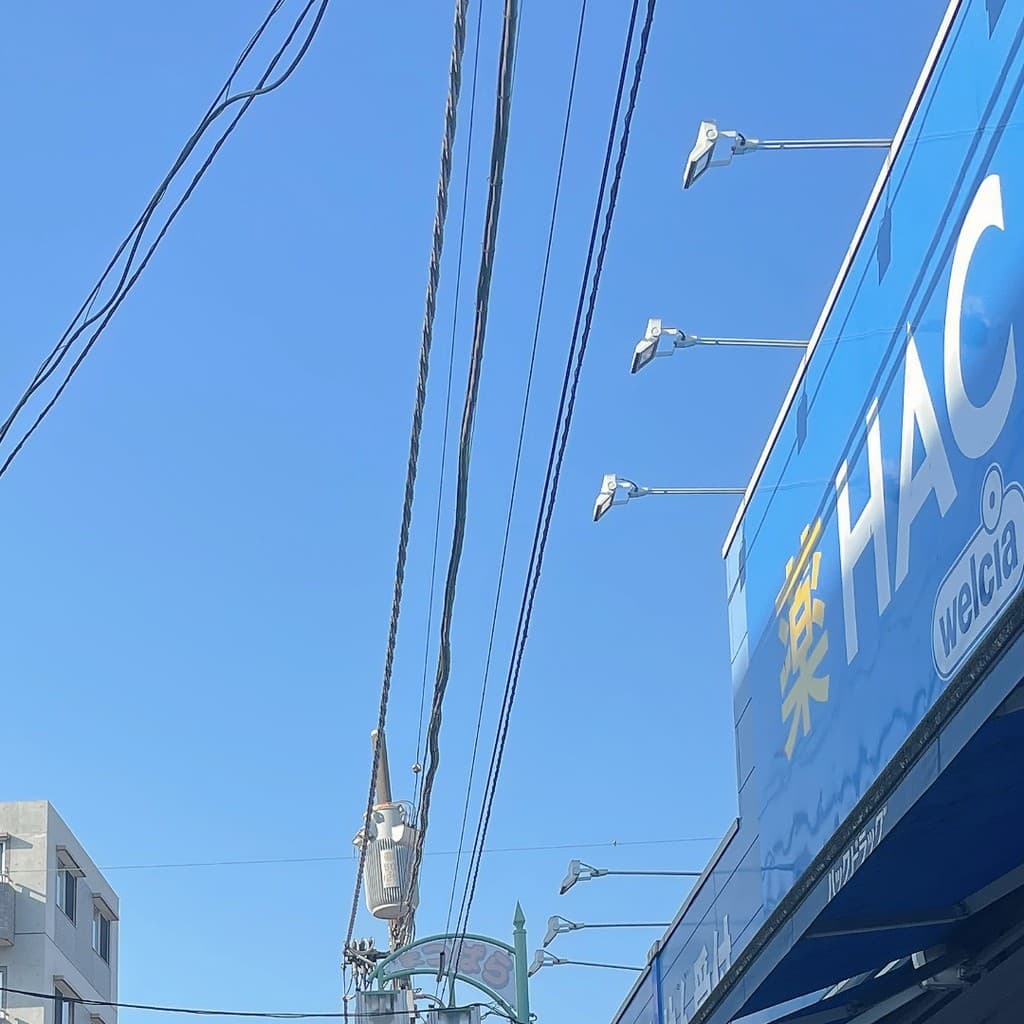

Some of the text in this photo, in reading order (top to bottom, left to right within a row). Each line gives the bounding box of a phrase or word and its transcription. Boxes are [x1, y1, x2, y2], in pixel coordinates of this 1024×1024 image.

[777, 174, 1017, 760] 薬 HAC
[939, 518, 1019, 658] welcia
[828, 806, 888, 903] ハックドラッグ
